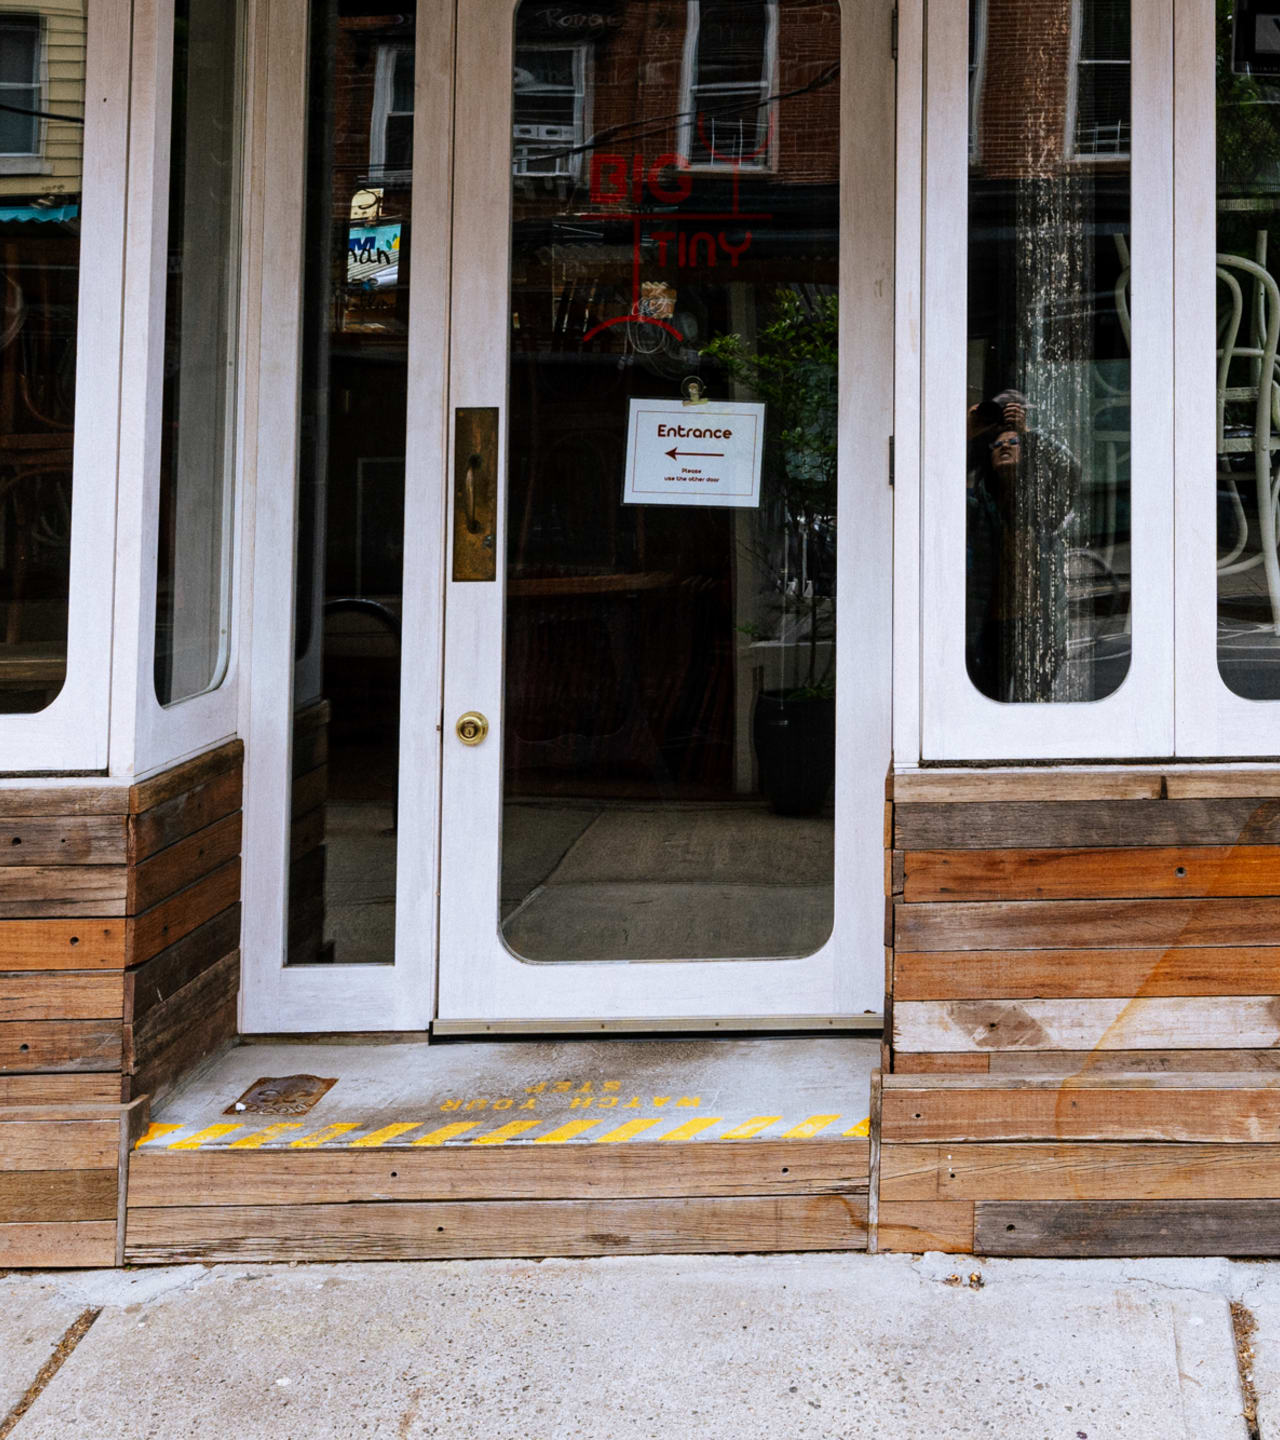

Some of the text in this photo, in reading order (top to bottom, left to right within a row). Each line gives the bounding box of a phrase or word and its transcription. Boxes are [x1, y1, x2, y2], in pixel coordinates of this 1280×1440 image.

[588, 152, 693, 205] BIG
[657, 423, 733, 440] Entrance
[524, 1080, 622, 1094] STEP
[439, 1095, 702, 1112] WATCH YOUR
